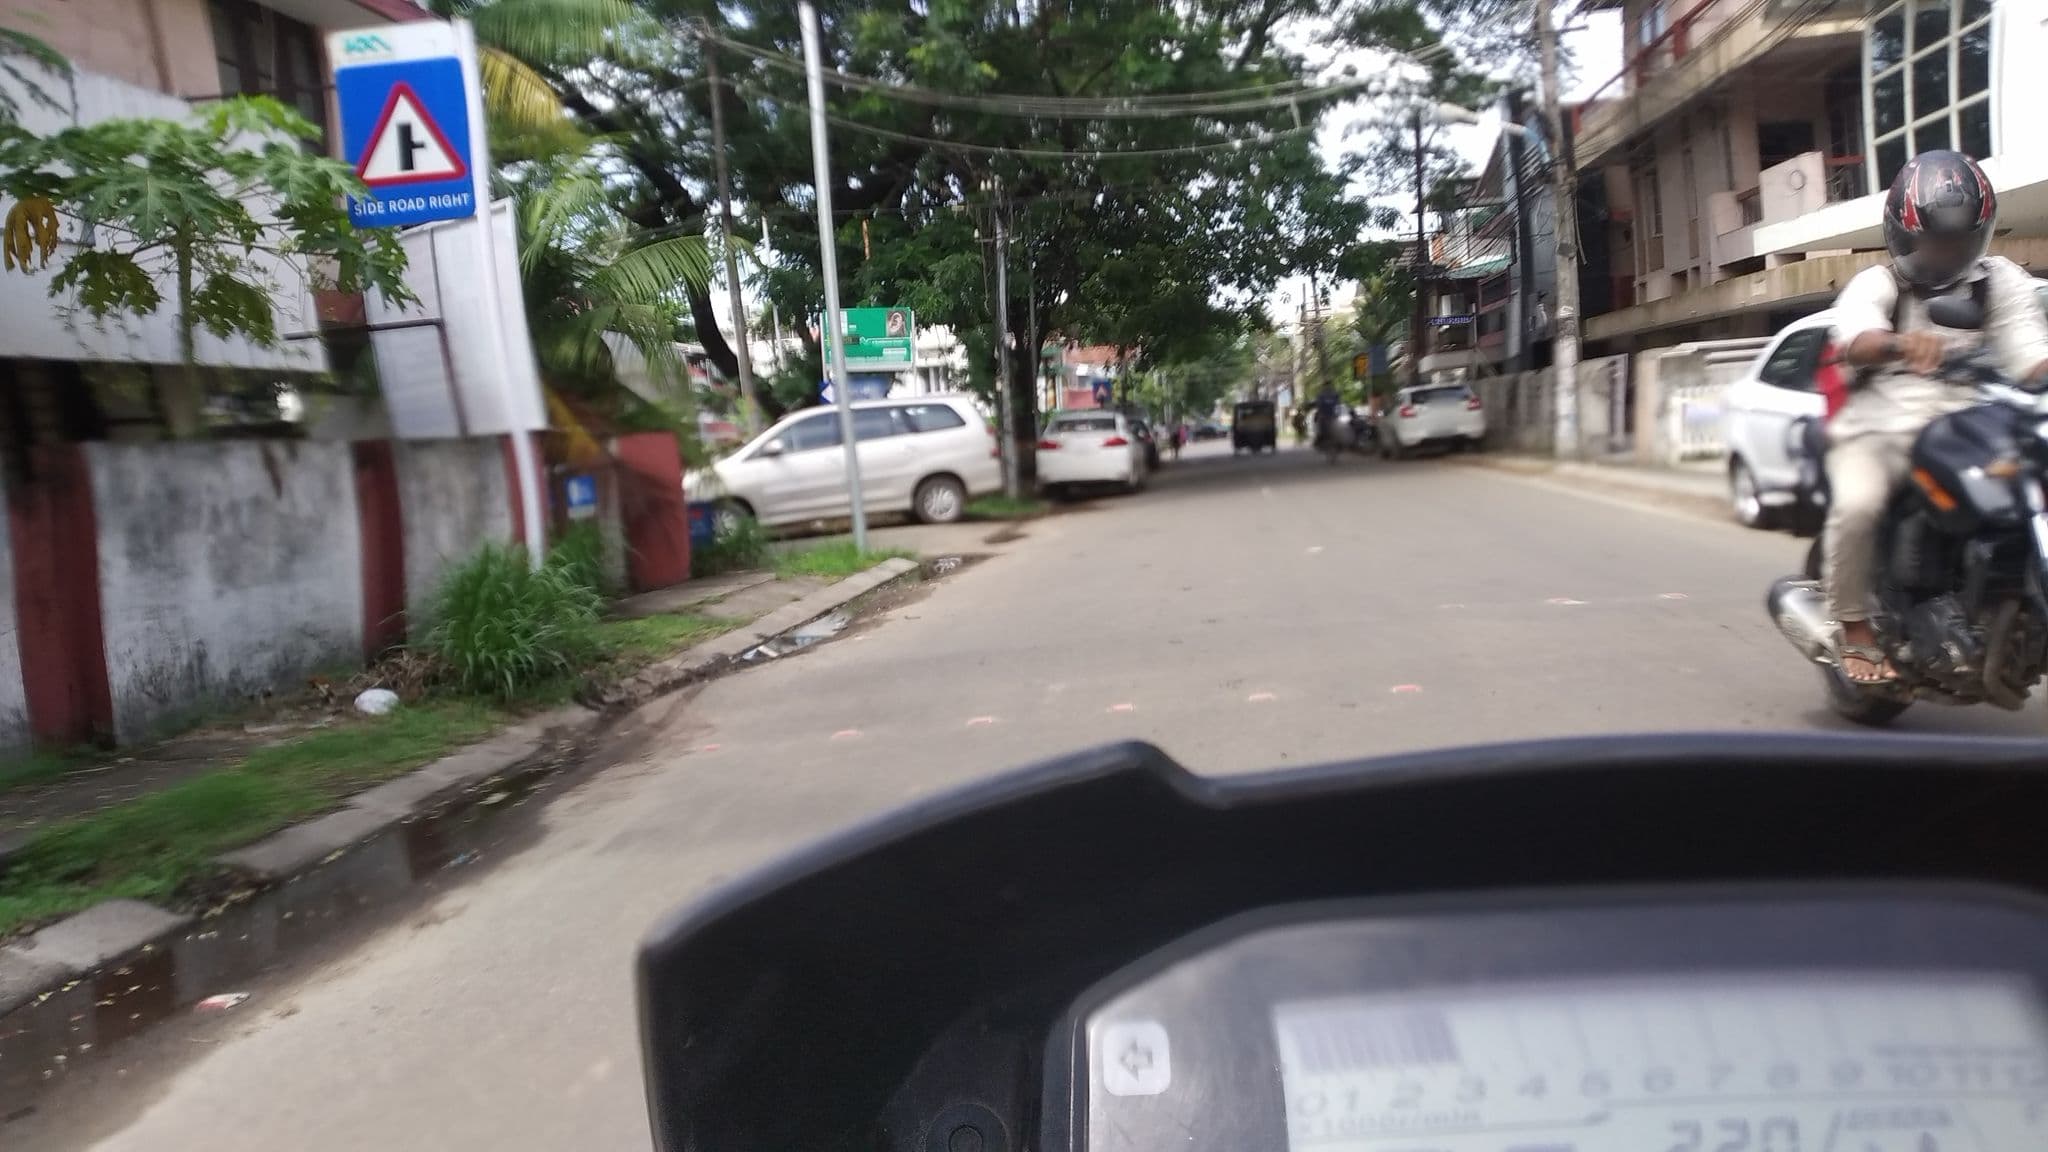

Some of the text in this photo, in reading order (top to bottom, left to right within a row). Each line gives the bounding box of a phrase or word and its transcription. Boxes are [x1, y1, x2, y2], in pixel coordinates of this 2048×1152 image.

[354, 192, 469, 216] SIDE ROAD RIGHT
[1390, 1080, 1425, 1109] 2
[1455, 1073, 1488, 1105] 3
[1706, 1062, 1736, 1090] 7
